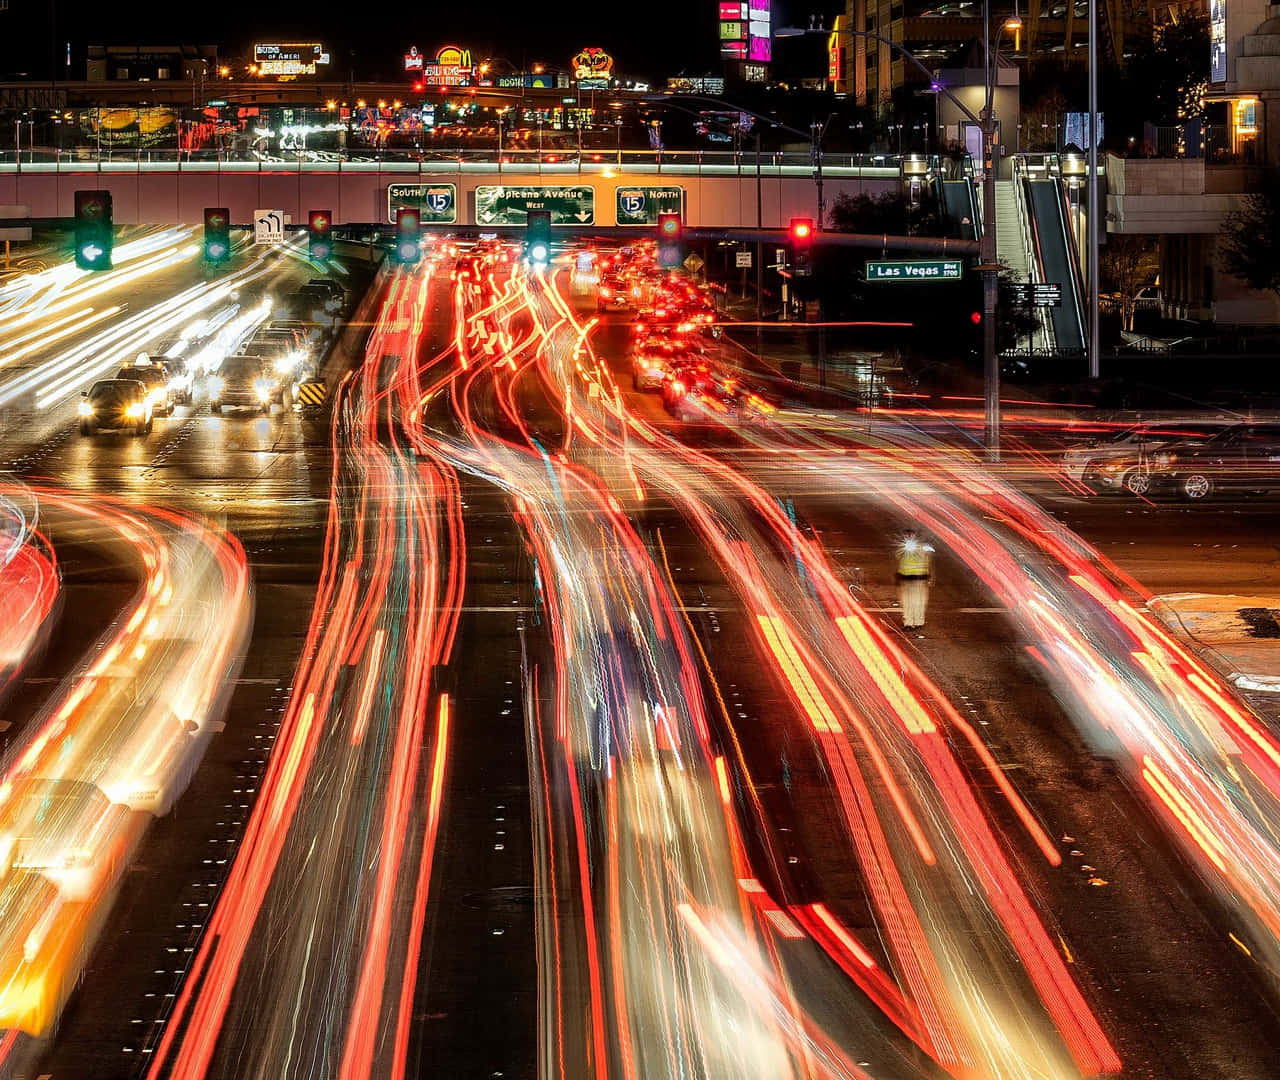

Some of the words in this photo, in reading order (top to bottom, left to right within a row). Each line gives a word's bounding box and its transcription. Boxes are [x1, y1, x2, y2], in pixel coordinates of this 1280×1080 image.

[487, 190, 540, 200] Topicana
[544, 190, 583, 198] Avenue
[432, 194, 446, 209] 15
[625, 197, 640, 210] 15
[877, 267, 900, 276] Las
[904, 266, 939, 277] Vegas
